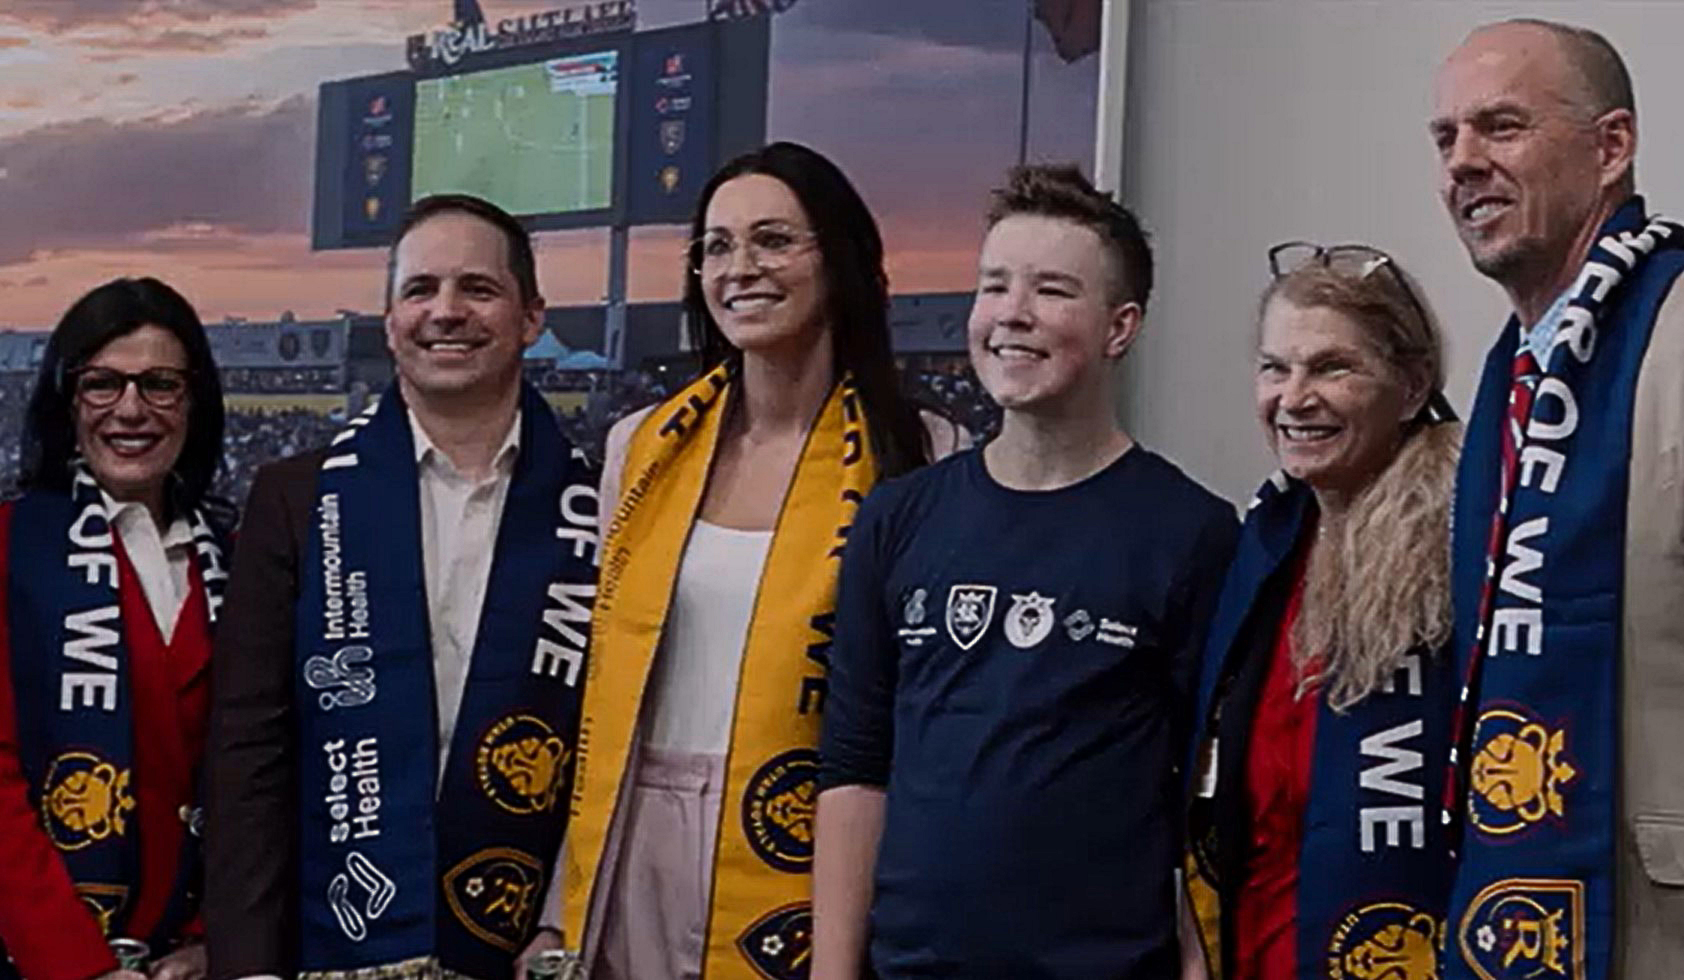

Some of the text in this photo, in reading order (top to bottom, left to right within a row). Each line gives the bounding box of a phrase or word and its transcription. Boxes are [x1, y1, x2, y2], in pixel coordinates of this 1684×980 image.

[1518, 376, 1579, 494] OF
[67, 503, 119, 589] OF
[531, 483, 600, 688] OF WE
[1487, 516, 1550, 656] WE
[60, 605, 120, 711] WE
[345, 570, 371, 639] Health
[350, 737, 382, 840] Health
[1359, 718, 1426, 854] WE
